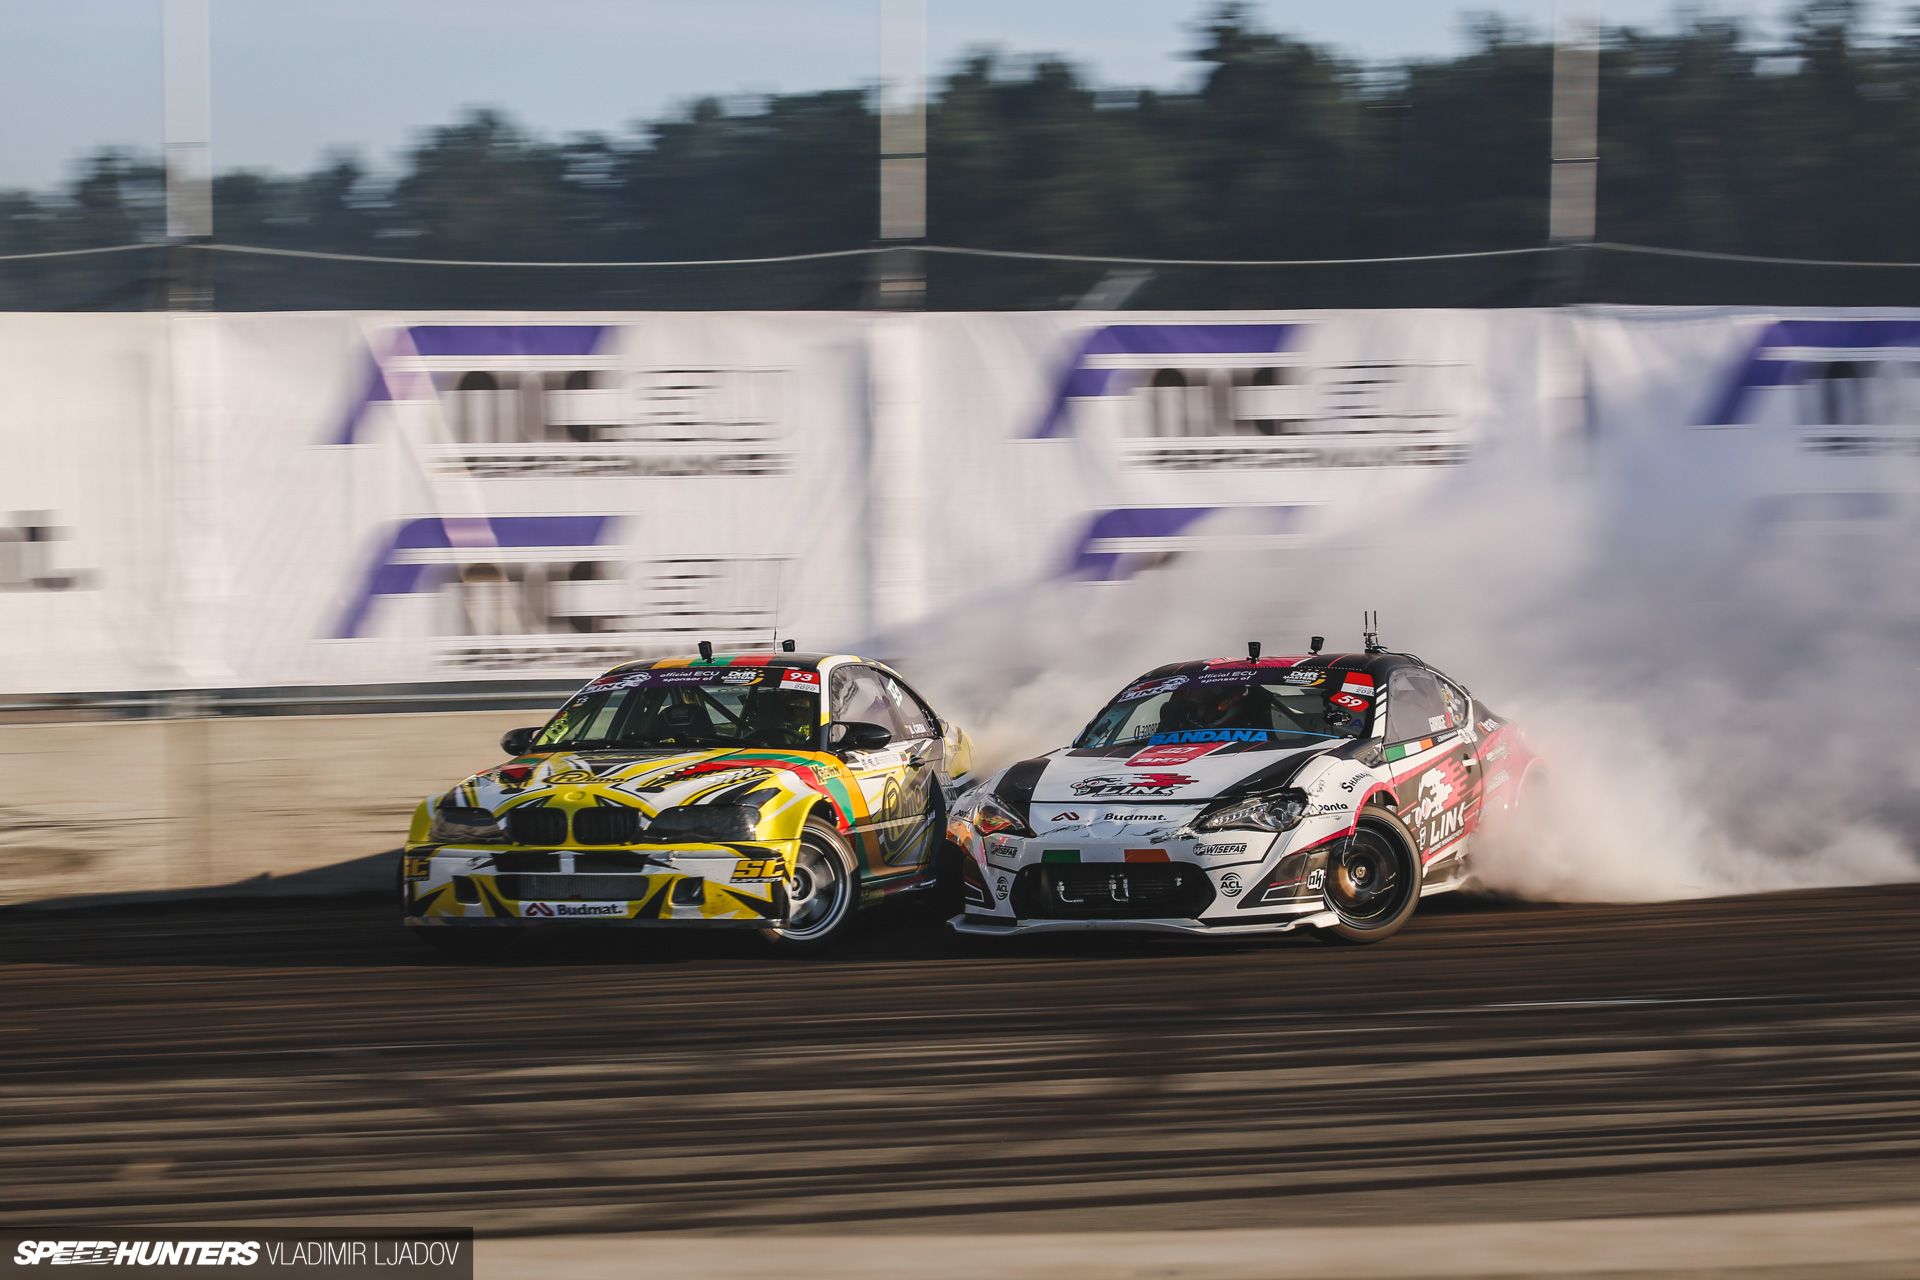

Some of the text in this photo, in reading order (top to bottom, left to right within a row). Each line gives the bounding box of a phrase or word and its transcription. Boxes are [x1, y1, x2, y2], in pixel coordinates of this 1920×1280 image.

[790, 672, 814, 682] 93
[1198, 672, 1230, 680] official
[1290, 670, 1319, 678] Drift
[1200, 676, 1238, 684] sponsor
[1337, 695, 1363, 707] 59
[1147, 730, 1269, 746] BANDANA
[1100, 786, 1183, 795] LINK
[1429, 801, 1466, 847] LINK
[1205, 844, 1248, 855] WISEFAB
[995, 884, 1009, 893] ACL
[1220, 881, 1243, 889] ACL
